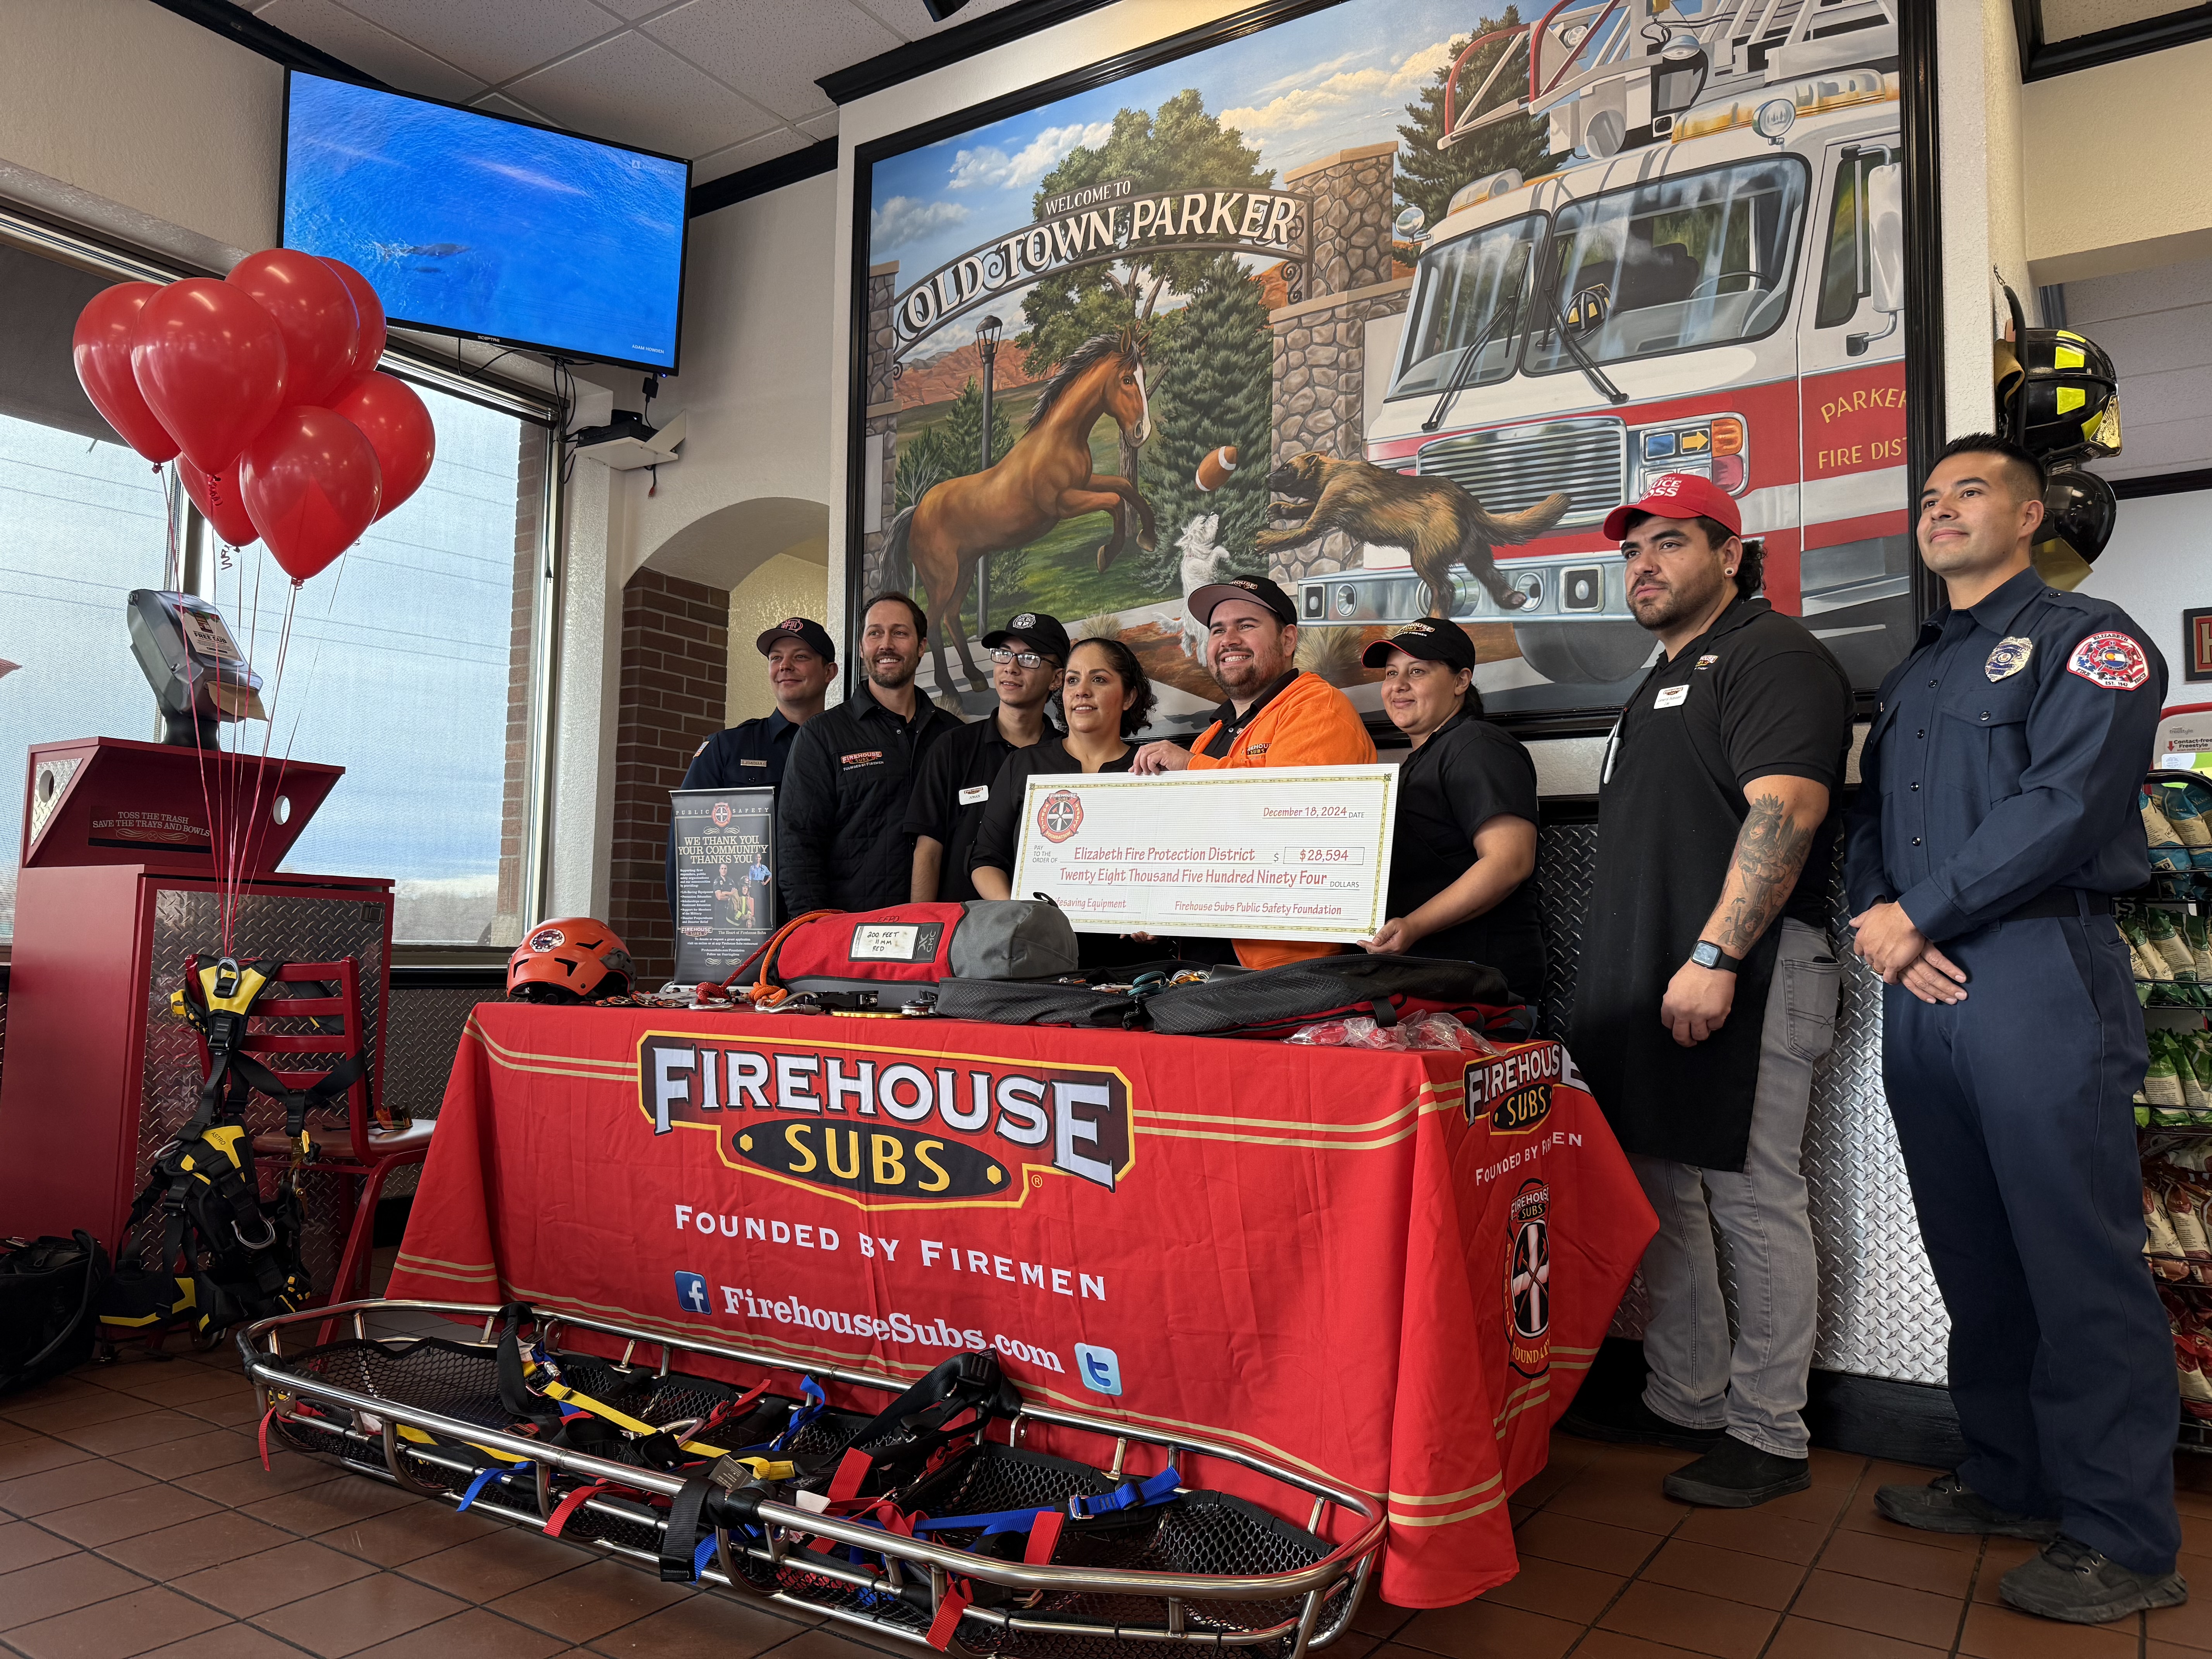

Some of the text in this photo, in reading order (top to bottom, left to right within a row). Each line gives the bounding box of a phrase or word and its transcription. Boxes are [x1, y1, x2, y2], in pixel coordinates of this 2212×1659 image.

[1045, 180, 1131, 216] WELCOME TO
[907, 192, 1297, 329] OLD TOWN PARKER
[1819, 437, 1907, 469] FIRE DIS
[1642, 487, 1679, 500] OSS
[194, 632, 212, 640] FREE
[2093, 634, 2129, 642] ELIZABETH
[2076, 668, 2091, 677] FIRE
[842, 752, 881, 764] FIREHOUSE
[161, 814, 189, 824] TRASH
[1263, 807, 1302, 817] December
[1305, 807, 1319, 818] 18,
[1321, 807, 1347, 816] 2024
[136, 820, 162, 828] TRAYS
[183, 826, 210, 837] BOWLS
[1046, 831, 1071, 839] FOUNDATION
[684, 837, 701, 846] WE
[702, 836, 737, 845] THANK
[678, 845, 769, 855] YOUR COMMUNITY
[1074, 847, 1348, 863] Elizabeth Fire Protection District $ $28,594
[690, 854, 753, 864] THANKS YOU.
[1060, 867, 1096, 884] Twenty
[1097, 868, 1126, 885] Eight
[1129, 868, 1180, 882] Thousand
[1182, 869, 1203, 883] Five
[1206, 869, 1254, 883] Hundred
[1257, 869, 1297, 887] Ninety
[1299, 870, 1327, 884] Four
[1054, 897, 1127, 912] ifesaving Equipment
[1175, 901, 1341, 916] Firehouse Subs Public Safety Foundation
[926, 929, 936, 952] CMC
[1468, 1044, 1592, 1127] FIREHOUSE
[1507, 1086, 1546, 1125] SUBS
[653, 1044, 1116, 1192] FIREHOUSE
[211, 1132, 226, 1145] ASTRO
[784, 1124, 951, 1192] SUBS
[1476, 1152, 1521, 1186] FOUNDED
[1525, 1145, 1538, 1161] BY
[1522, 1204, 1542, 1218] SUBS
[674, 1204, 1106, 1301] FOUNDED BY FIREMEN
[720, 1285, 1065, 1373] FirehouseSubs.com
